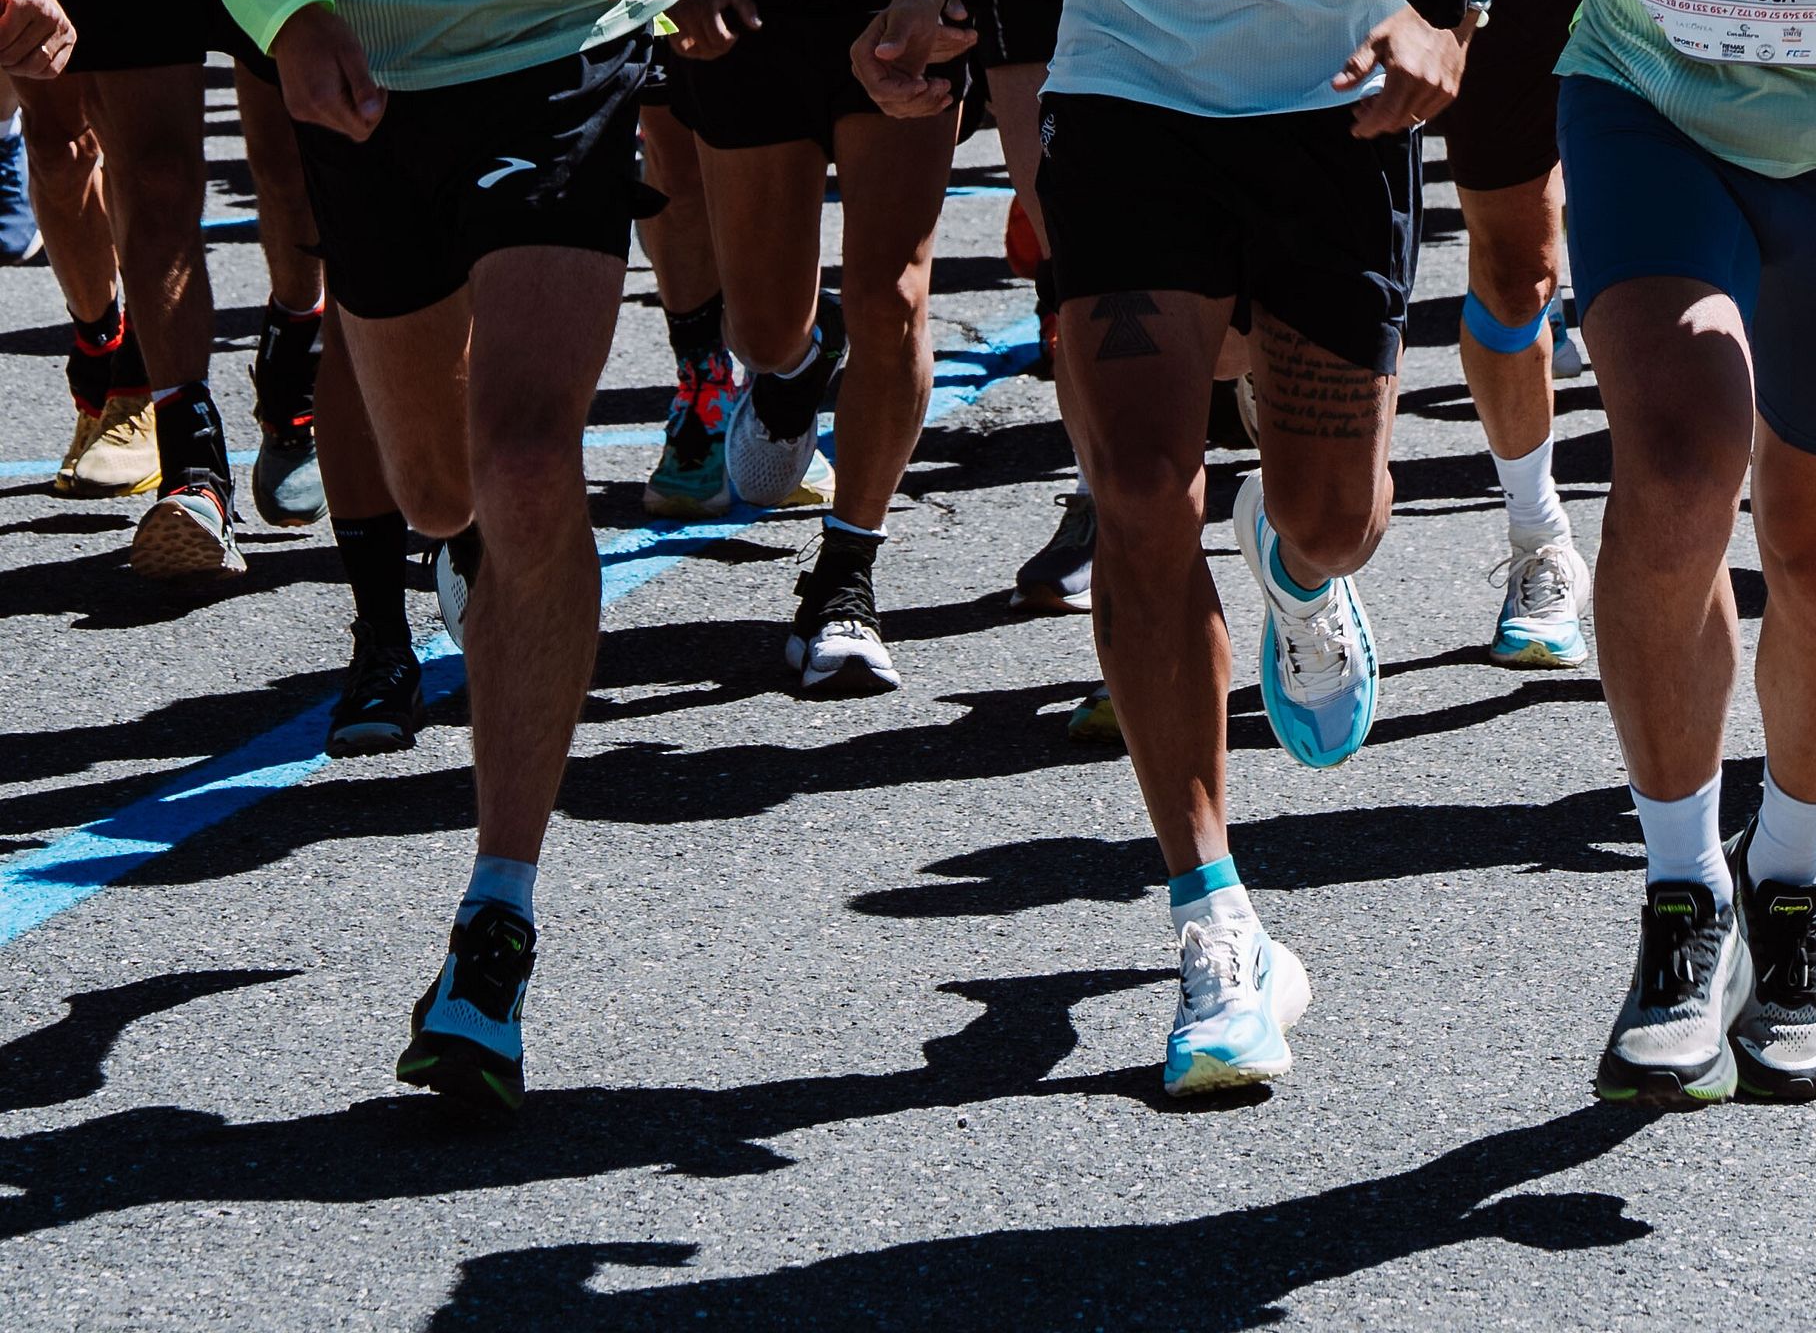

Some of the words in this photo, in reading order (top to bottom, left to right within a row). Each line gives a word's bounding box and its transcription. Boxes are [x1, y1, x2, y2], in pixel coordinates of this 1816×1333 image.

[1679, 1, 1691, 10] 69
[1693, 4, 1708, 13] 331
[1710, 6, 1728, 15] +39
[1737, 9, 1753, 17] 172
[1755, 10, 1767, 18] 60
[1770, 11, 1780, 19] 57
[1783, 11, 1801, 19] 349
